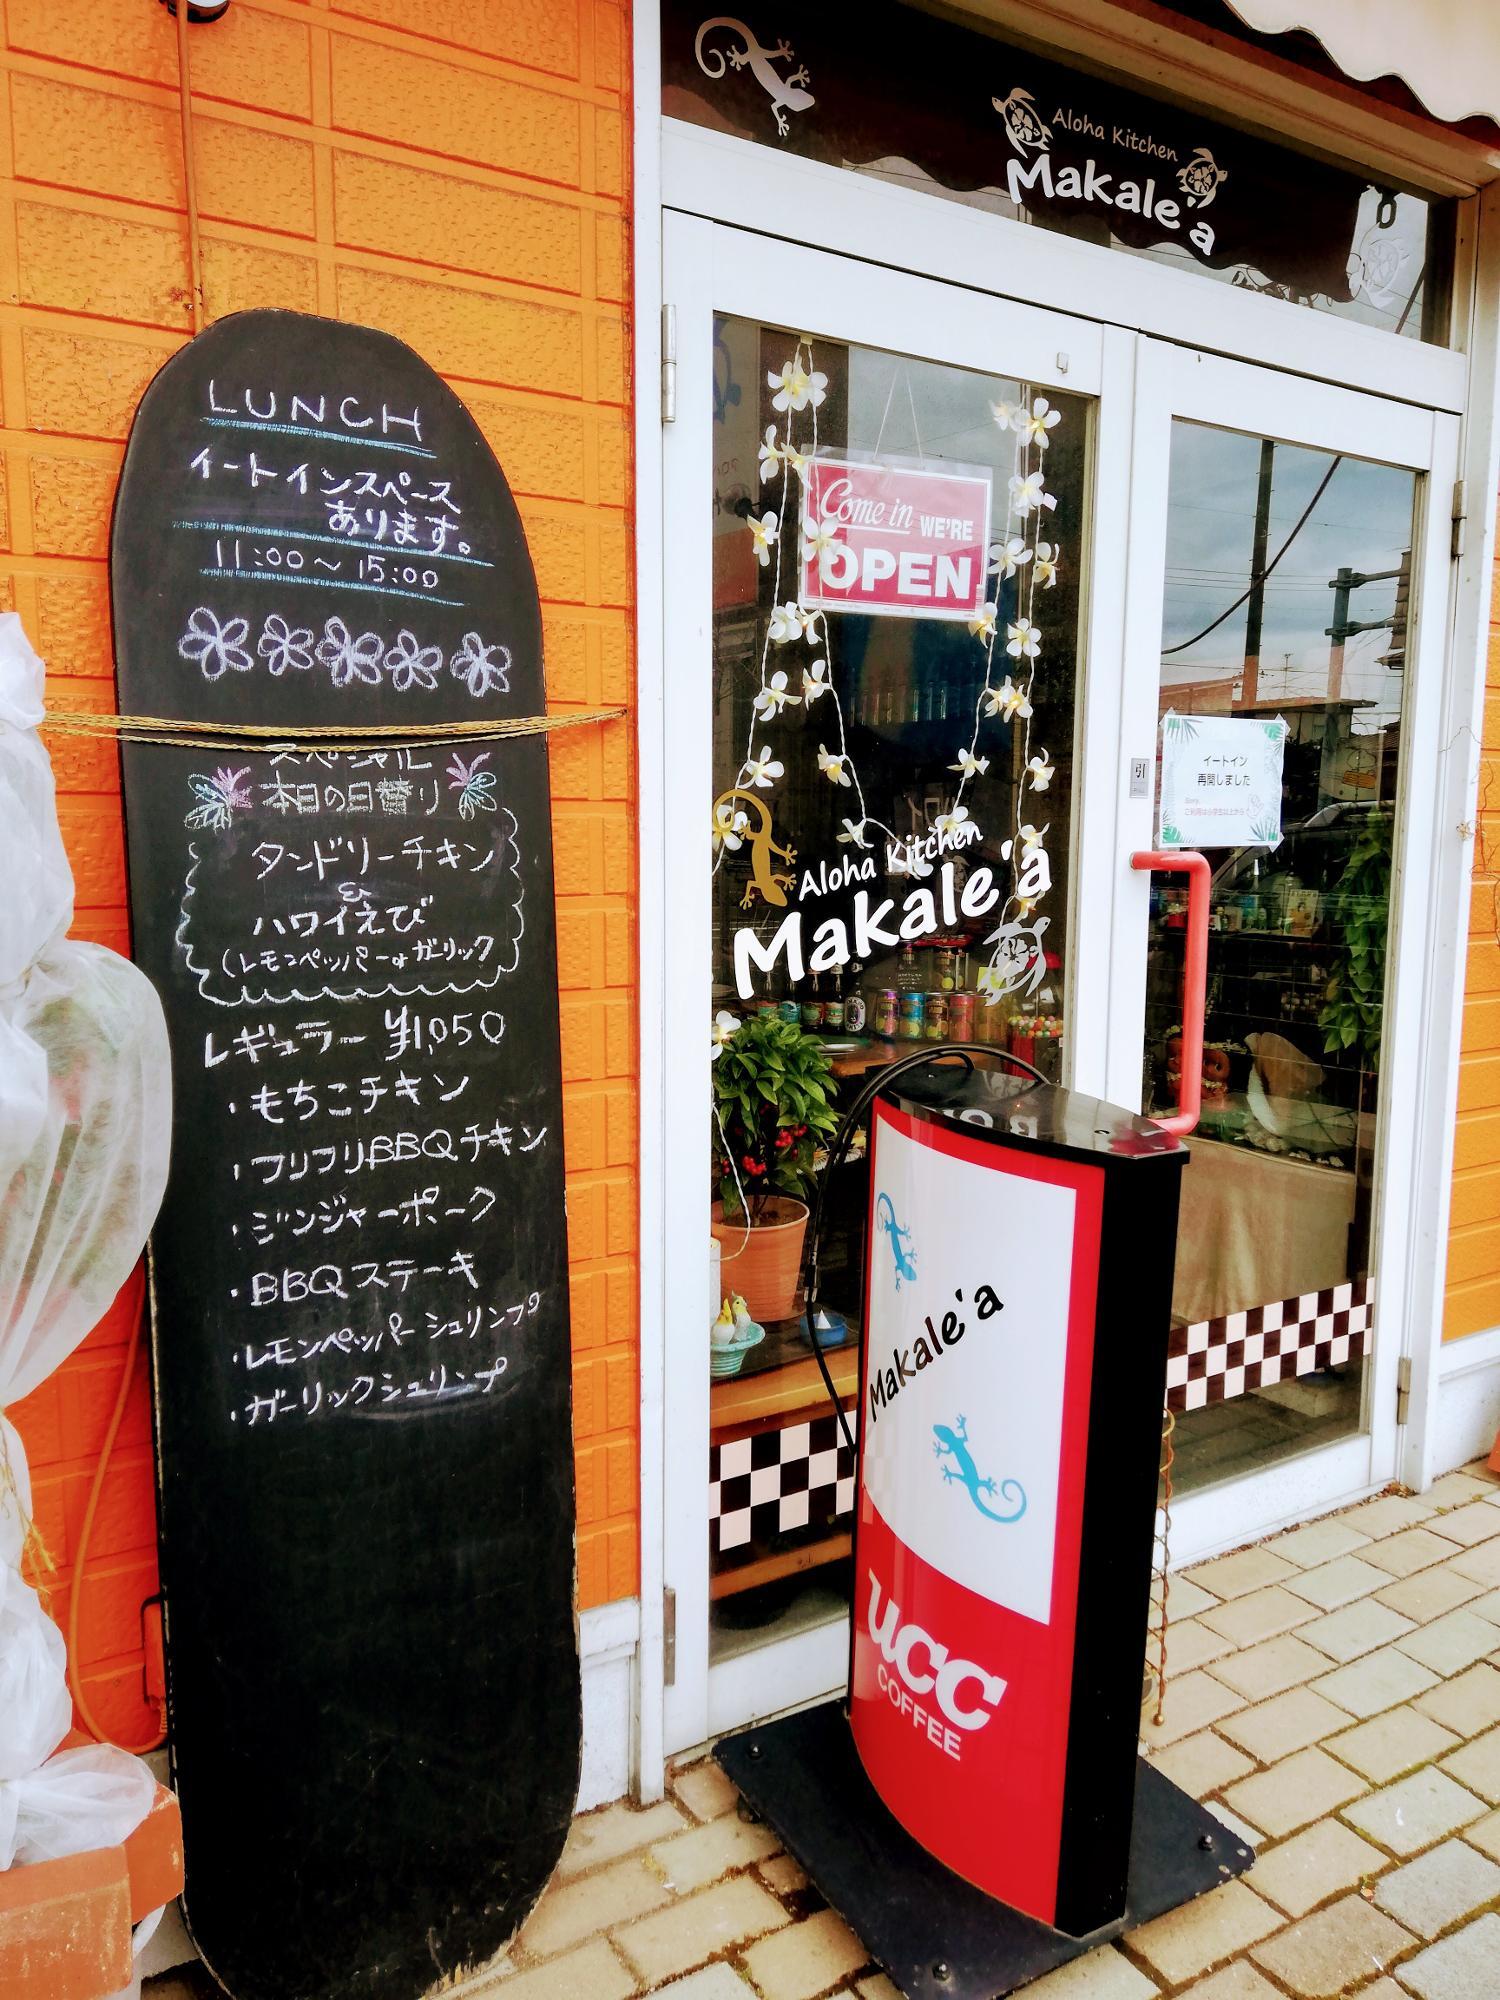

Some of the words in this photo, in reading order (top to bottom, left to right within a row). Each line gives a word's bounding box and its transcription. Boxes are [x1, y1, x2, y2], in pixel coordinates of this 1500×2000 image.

[1052, 107, 1105, 140] Aloha
[1112, 127, 1179, 162] Kitchen
[1006, 154, 1216, 256] Makale'a
[208, 379, 423, 441] LUNCH
[190, 447, 462, 514] イートインスペース
[325, 499, 471, 556] あります。
[821, 478, 885, 524] Come
[889, 497, 913, 529] in
[920, 514, 974, 541] WE'RE
[821, 544, 972, 600] OPEN
[265, 743, 433, 770] スペシャル
[1197, 773, 1250, 787] 再開しました
[1203, 755, 1248, 767] イートイン
[252, 836, 494, 880] タンドリーチキン
[799, 855, 877, 901] Aloha
[886, 821, 984, 873] Kitchen
[252, 895, 434, 938] ハワイえび
[734, 839, 1052, 1000] Makale'a
[204, 1022, 367, 1068] レギュラー
[869, 1284, 1004, 1423] Makale'a
[877, 1664, 961, 1761] COFFEE
